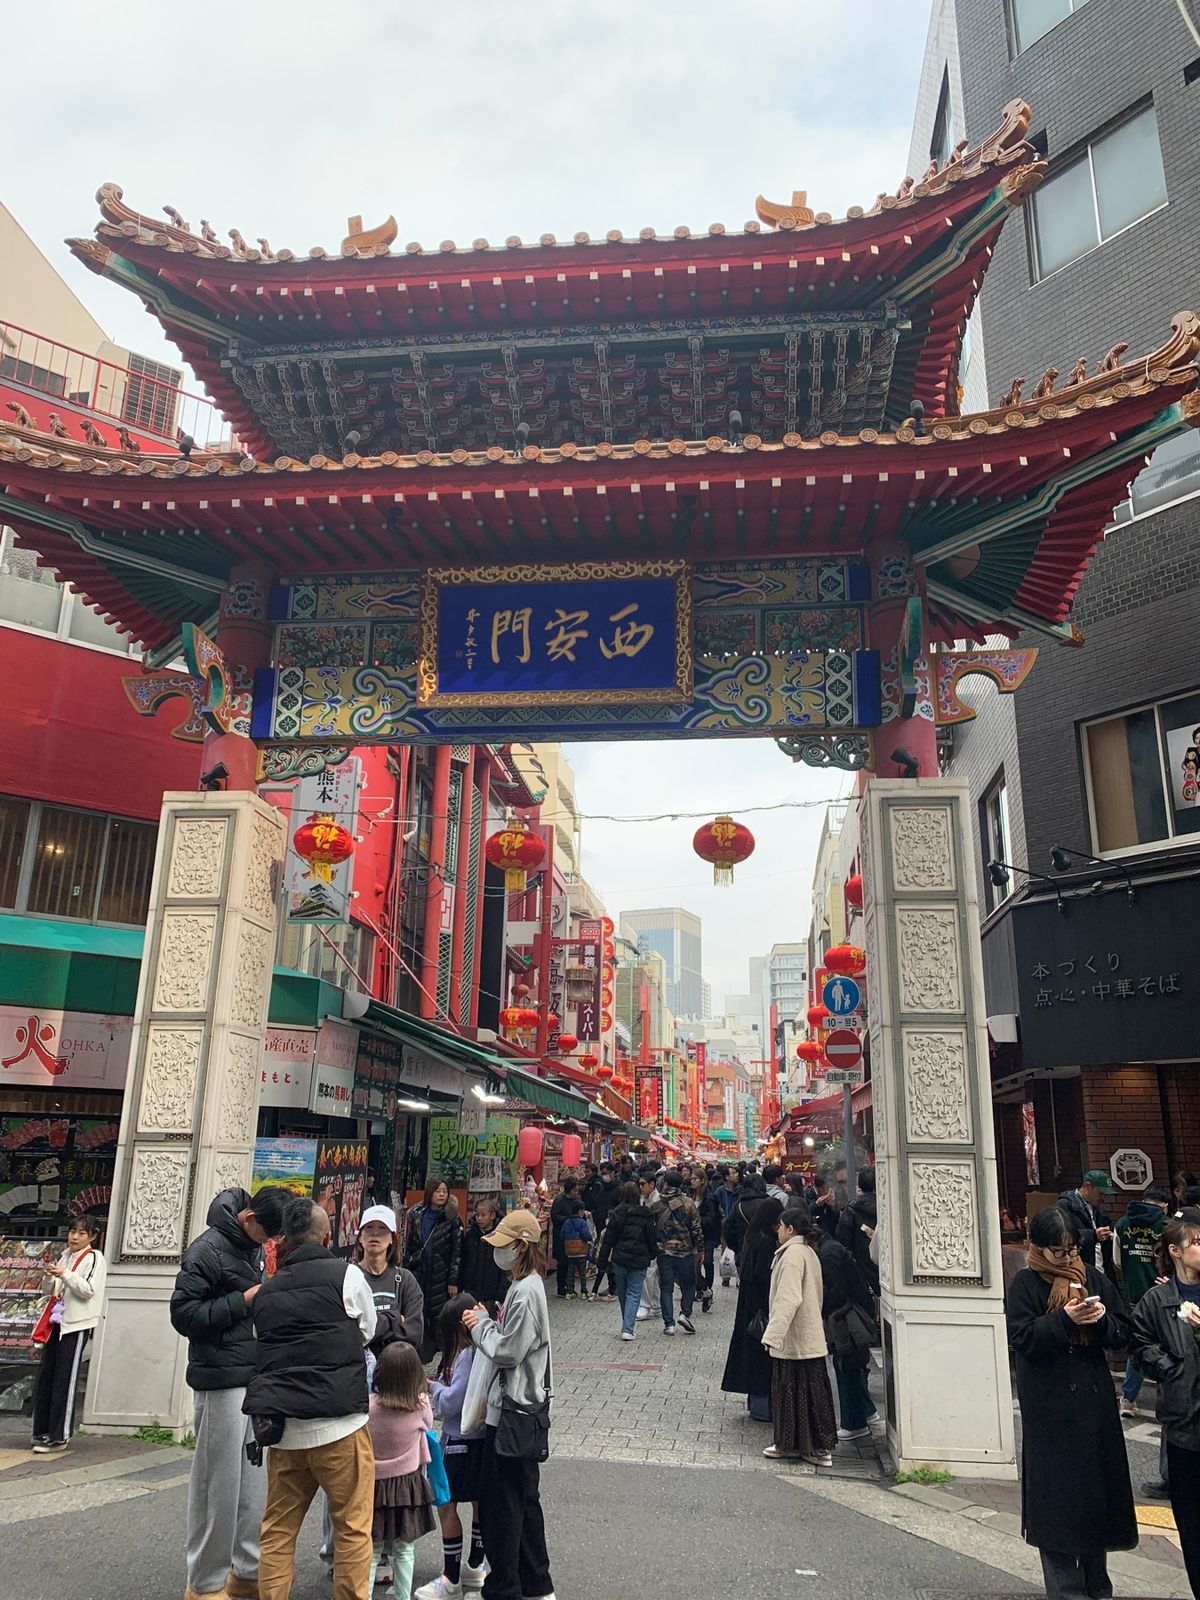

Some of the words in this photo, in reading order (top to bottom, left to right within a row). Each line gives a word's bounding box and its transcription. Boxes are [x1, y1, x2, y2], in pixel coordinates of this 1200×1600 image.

[316, 769, 335, 803] 熊本
[1031, 951, 1120, 981] 本づくり
[1034, 973, 1182, 1008] 点心・中華そば
[61, 1039, 106, 1052] OHKA
[265, 1037, 309, 1054] 産直売
